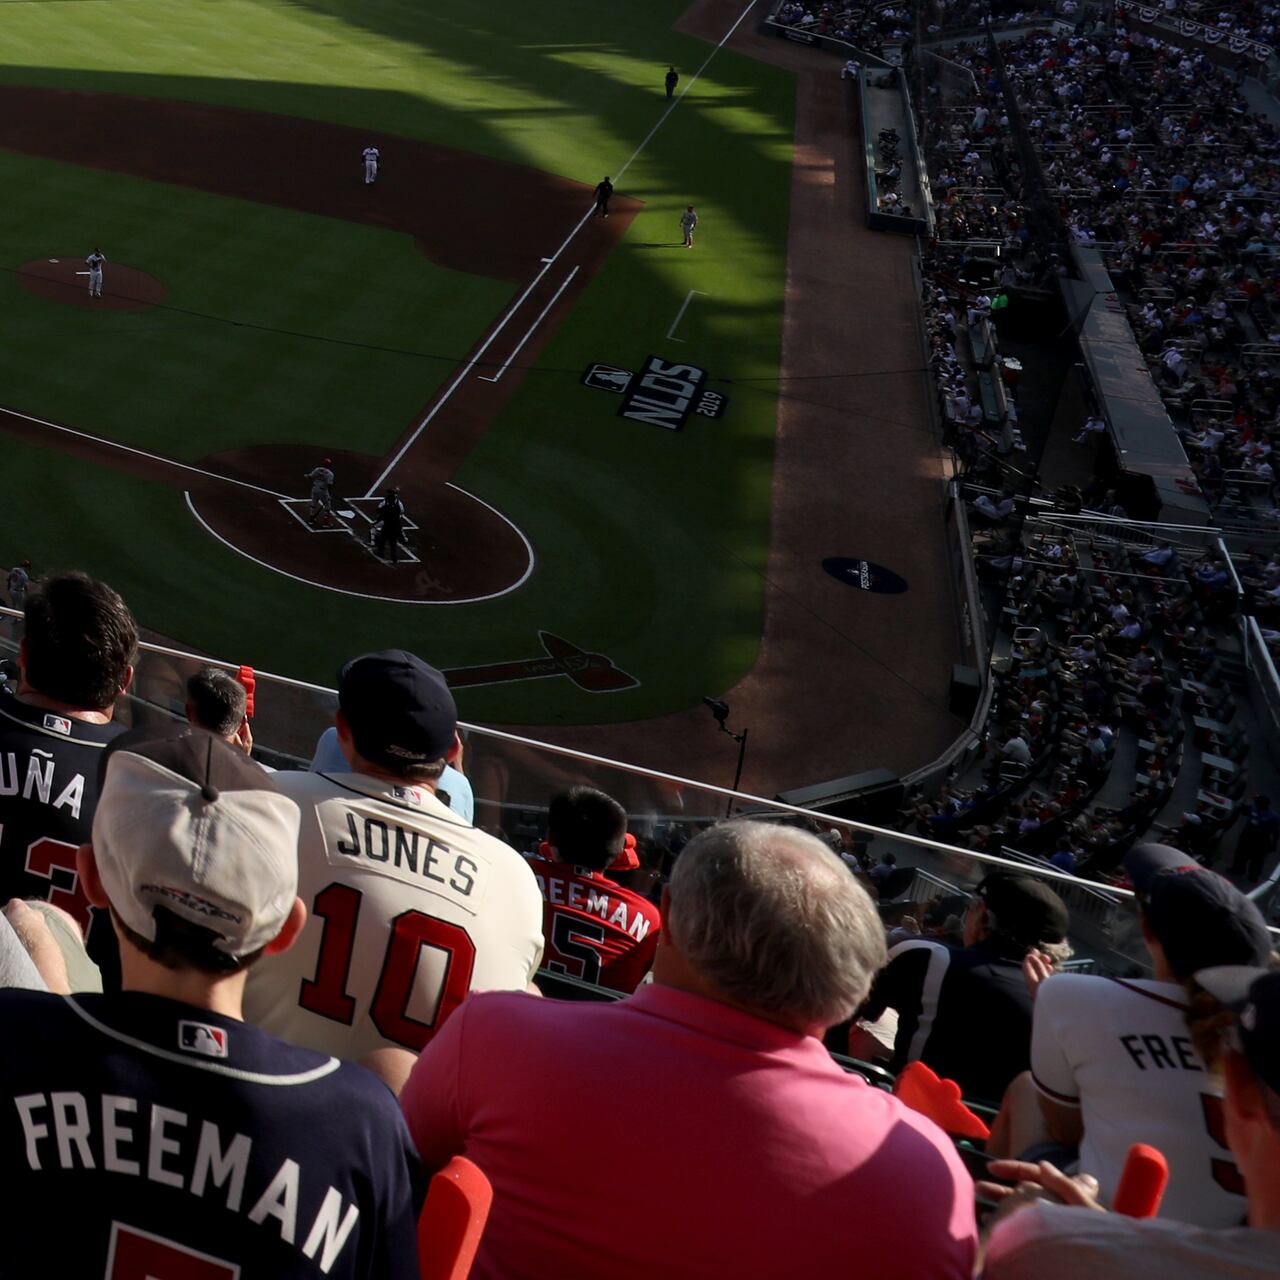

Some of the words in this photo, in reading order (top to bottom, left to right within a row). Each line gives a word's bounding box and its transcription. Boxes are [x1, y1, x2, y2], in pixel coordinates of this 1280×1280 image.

[623, 358, 703, 429] NLDS
[696, 391, 723, 417] 2019
[336, 812, 478, 898] JONES
[535, 874, 651, 943] REEMAN
[297, 882, 477, 1052] 10
[548, 912, 605, 986] 5
[14, 1091, 360, 1273] FREEMAN
